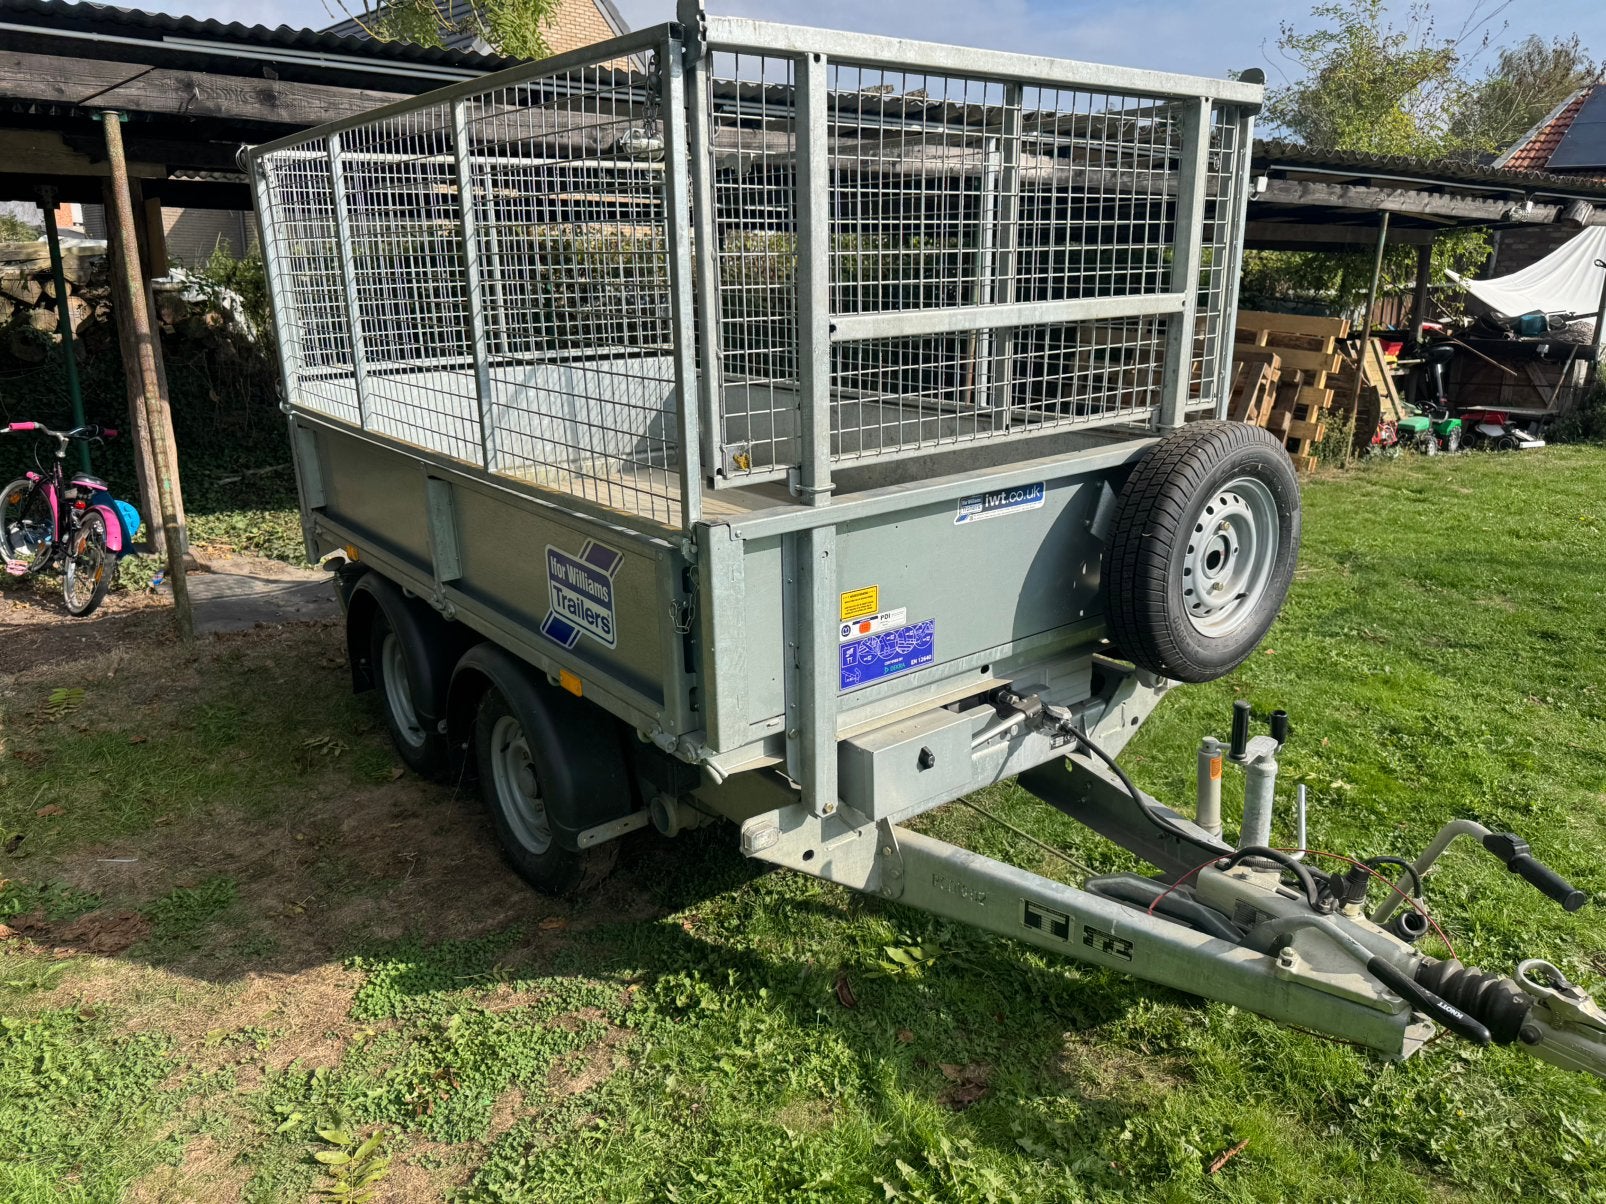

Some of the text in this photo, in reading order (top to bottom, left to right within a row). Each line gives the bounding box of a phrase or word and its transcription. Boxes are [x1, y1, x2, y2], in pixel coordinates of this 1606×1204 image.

[985, 485, 1040, 507] iwt.co.uk
[550, 556, 609, 602] Ifor Williams
[553, 584, 611, 635] Trailers
[880, 613, 891, 621] PDI
[1437, 1002, 1464, 1019] KNOTT
